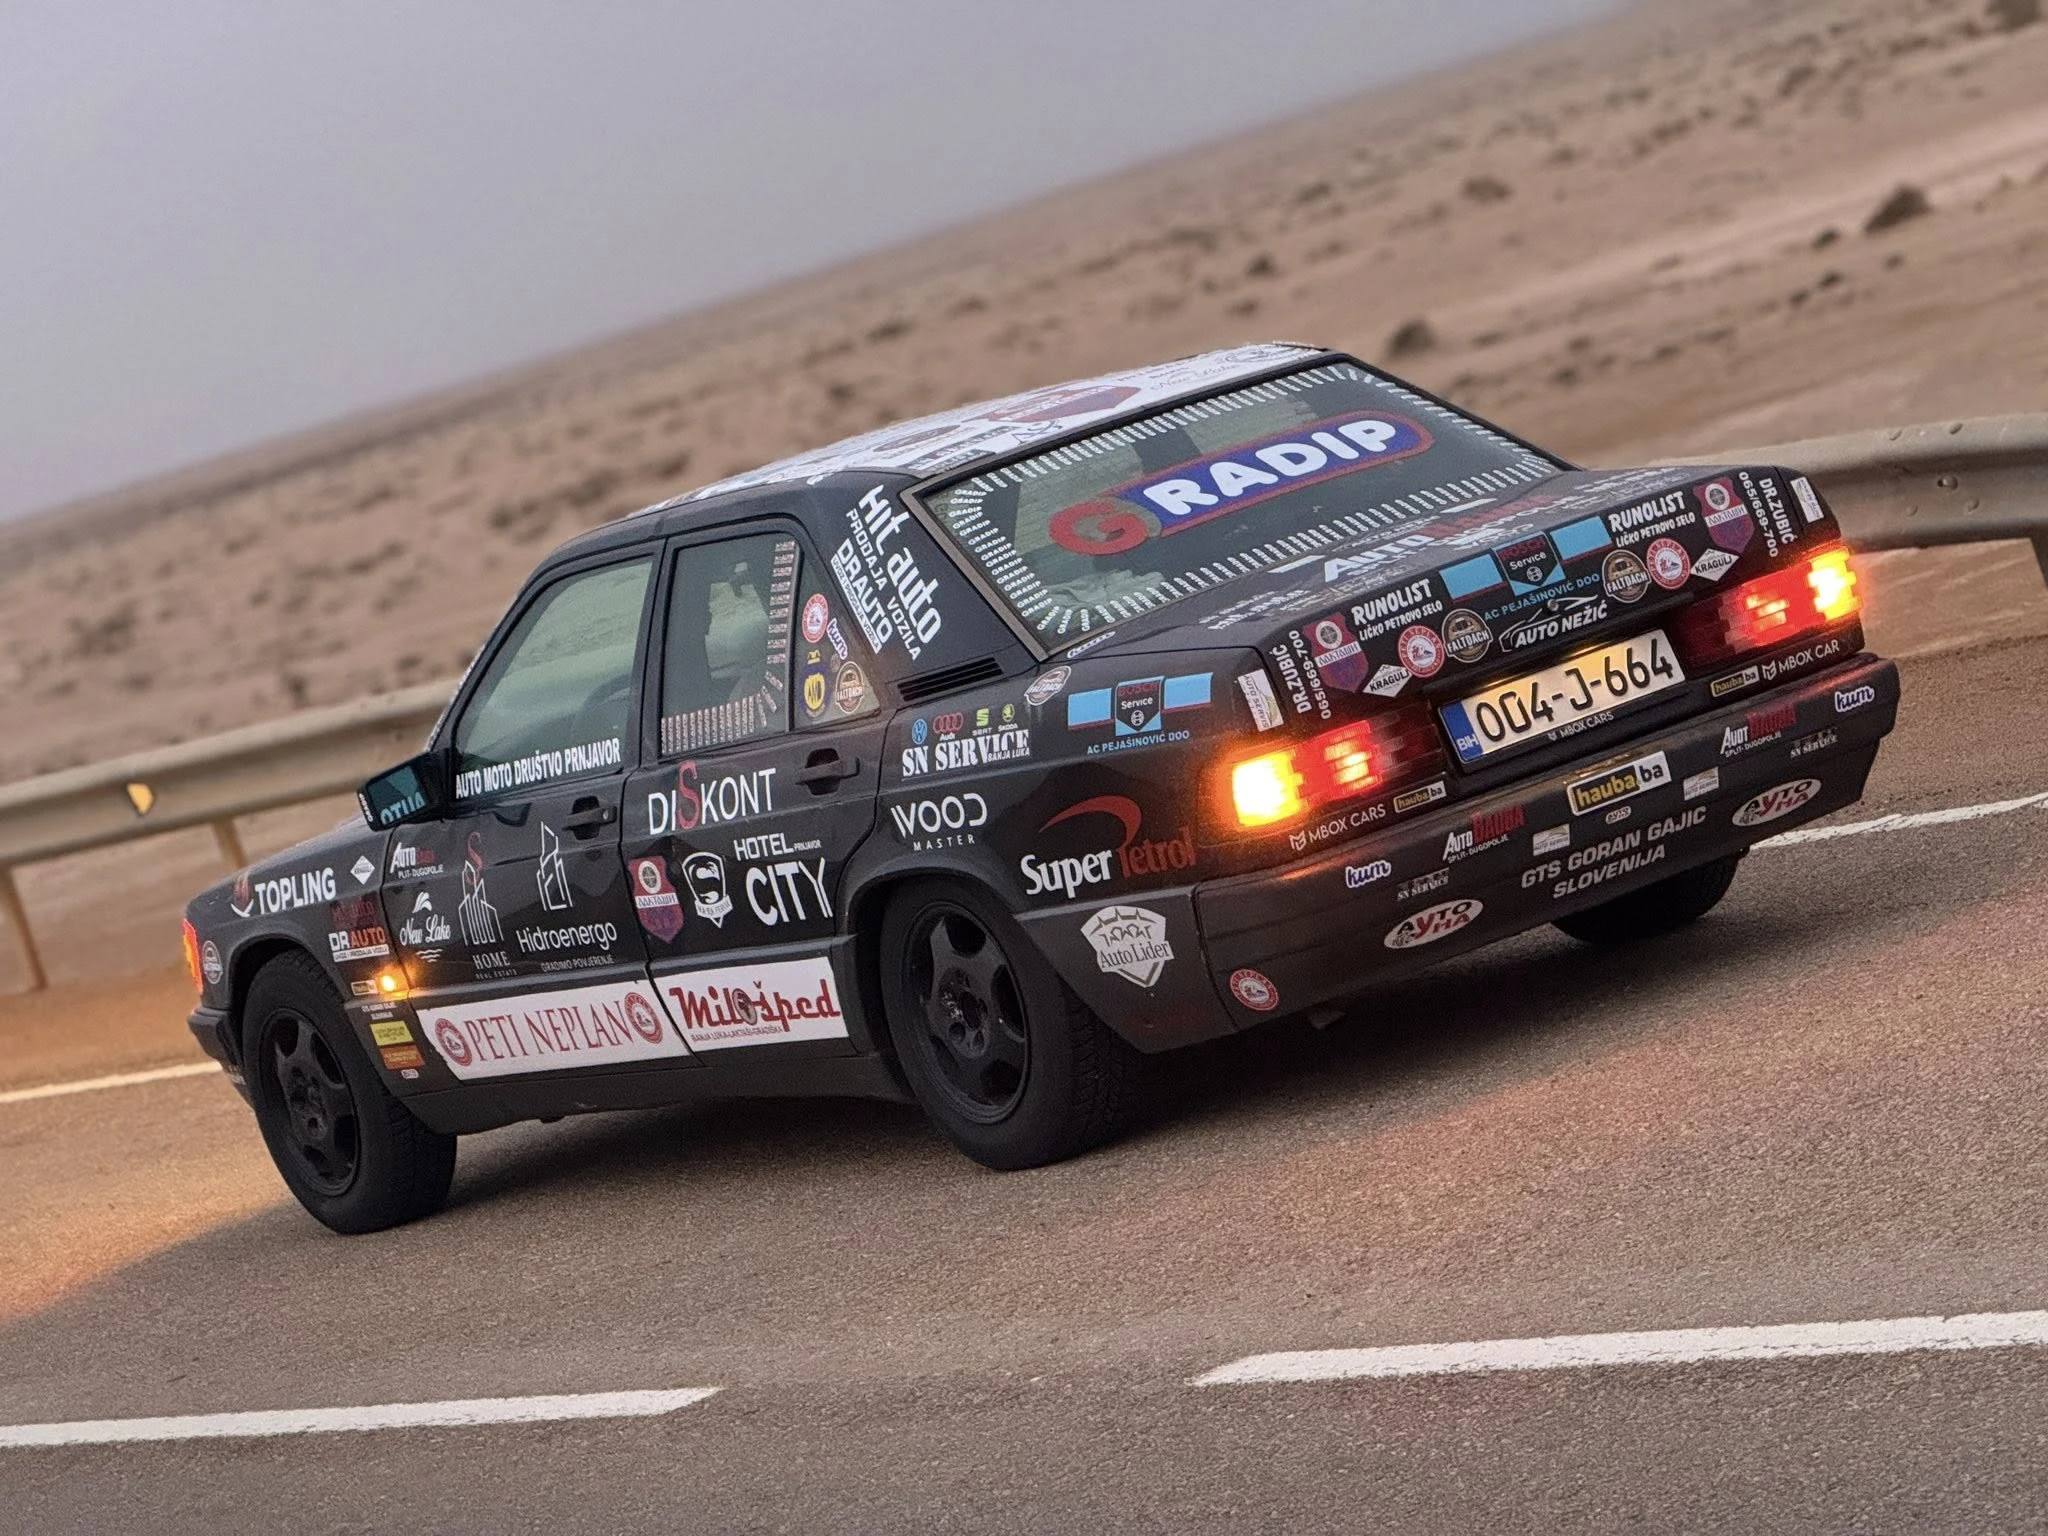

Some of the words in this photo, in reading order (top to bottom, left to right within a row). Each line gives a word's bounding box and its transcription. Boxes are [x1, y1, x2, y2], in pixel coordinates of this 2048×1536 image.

[1047, 419, 1396, 556] GRADIP
[949, 506, 982, 518] GRADIP
[953, 512, 983, 529] GRADIP
[1608, 491, 1686, 533] RUNOLIST
[1641, 519, 1676, 540] PETROVO
[1677, 511, 1696, 526] SELO
[1739, 471, 1779, 558] 065/669-700
[959, 520, 991, 536] GRADIP
[968, 527, 999, 546] GRADIP
[974, 536, 1006, 553] GRADIP
[981, 543, 1012, 561] GRADIP
[857, 484, 910, 557] Hit
[887, 547, 942, 644] auto
[986, 550, 1017, 568] GRADIP
[991, 557, 1023, 576] GRADIP
[1510, 552, 1547, 570] Service
[846, 507, 889, 591] PRODAJA
[887, 596, 921, 661] VOZILA
[996, 565, 1028, 584] GRADIP
[1004, 573, 1035, 591] GRADIP
[1606, 570, 1649, 593] FALTDACH
[1010, 581, 1041, 600] GRADIP
[1017, 589, 1048, 608] GRADIP
[1351, 578, 1433, 626] RUNOLIST
[1484, 609, 1500, 621] AC
[1576, 572, 1600, 587] DOO
[1021, 597, 1053, 618] GRADIP
[1359, 621, 1384, 641] LIČKO
[1385, 608, 1422, 631] PETROVO
[1423, 600, 1443, 617] SELO
[1515, 622, 1559, 648] AUTO
[1562, 600, 1608, 633] NEŽIĆ
[1447, 630, 1490, 653] FALTDACH
[1289, 630, 1331, 720] 065/669-700
[1778, 650, 1813, 673] MBOX
[1121, 696, 1154, 710] Service
[1243, 675, 1256, 696] AUTO
[1252, 698, 1270, 728] SERVIS
[1476, 638, 1674, 743] 004-J-664
[1836, 687, 1873, 711] kum
[1560, 721, 1586, 738] MBOX
[1587, 711, 1614, 729] CARS
[902, 746, 929, 777] SN
[935, 729, 1030, 771] SERVICE
[1012, 747, 1030, 760] LUKA
[1087, 744, 1101, 755] AC
[1169, 730, 1190, 741] DOO
[1456, 733, 1479, 751] BIH
[456, 772, 482, 799] AUTO
[483, 765, 512, 792] MOTO
[514, 750, 562, 786] DRUŠTVO
[565, 738, 621, 774] PRNJAVOR
[648, 759, 776, 835] DISKONT
[891, 793, 988, 839] WOOD
[1309, 816, 1348, 843] MBOX
[1350, 803, 1386, 828] CARS
[733, 833, 794, 861] HOTEL
[913, 834, 975, 851] MASTER
[1521, 859, 1562, 889] GTS
[1568, 829, 1641, 871] GORAN
[1647, 806, 1707, 842] GAJIC
[389, 842, 416, 873] AUTO
[1553, 844, 1666, 899] SLOVENIJA
[1020, 849, 1113, 899] Super
[1348, 863, 1389, 886] kum
[255, 867, 336, 914] TOPLING
[745, 857, 833, 926] CITY
[400, 918, 422, 946] New
[425, 913, 451, 942] Lake
[516, 921, 618, 954] Hidroenergo
[473, 951, 510, 970] HOME
[464, 1014, 530, 1062] PETI
[523, 1000, 634, 1054] NEPLAN
